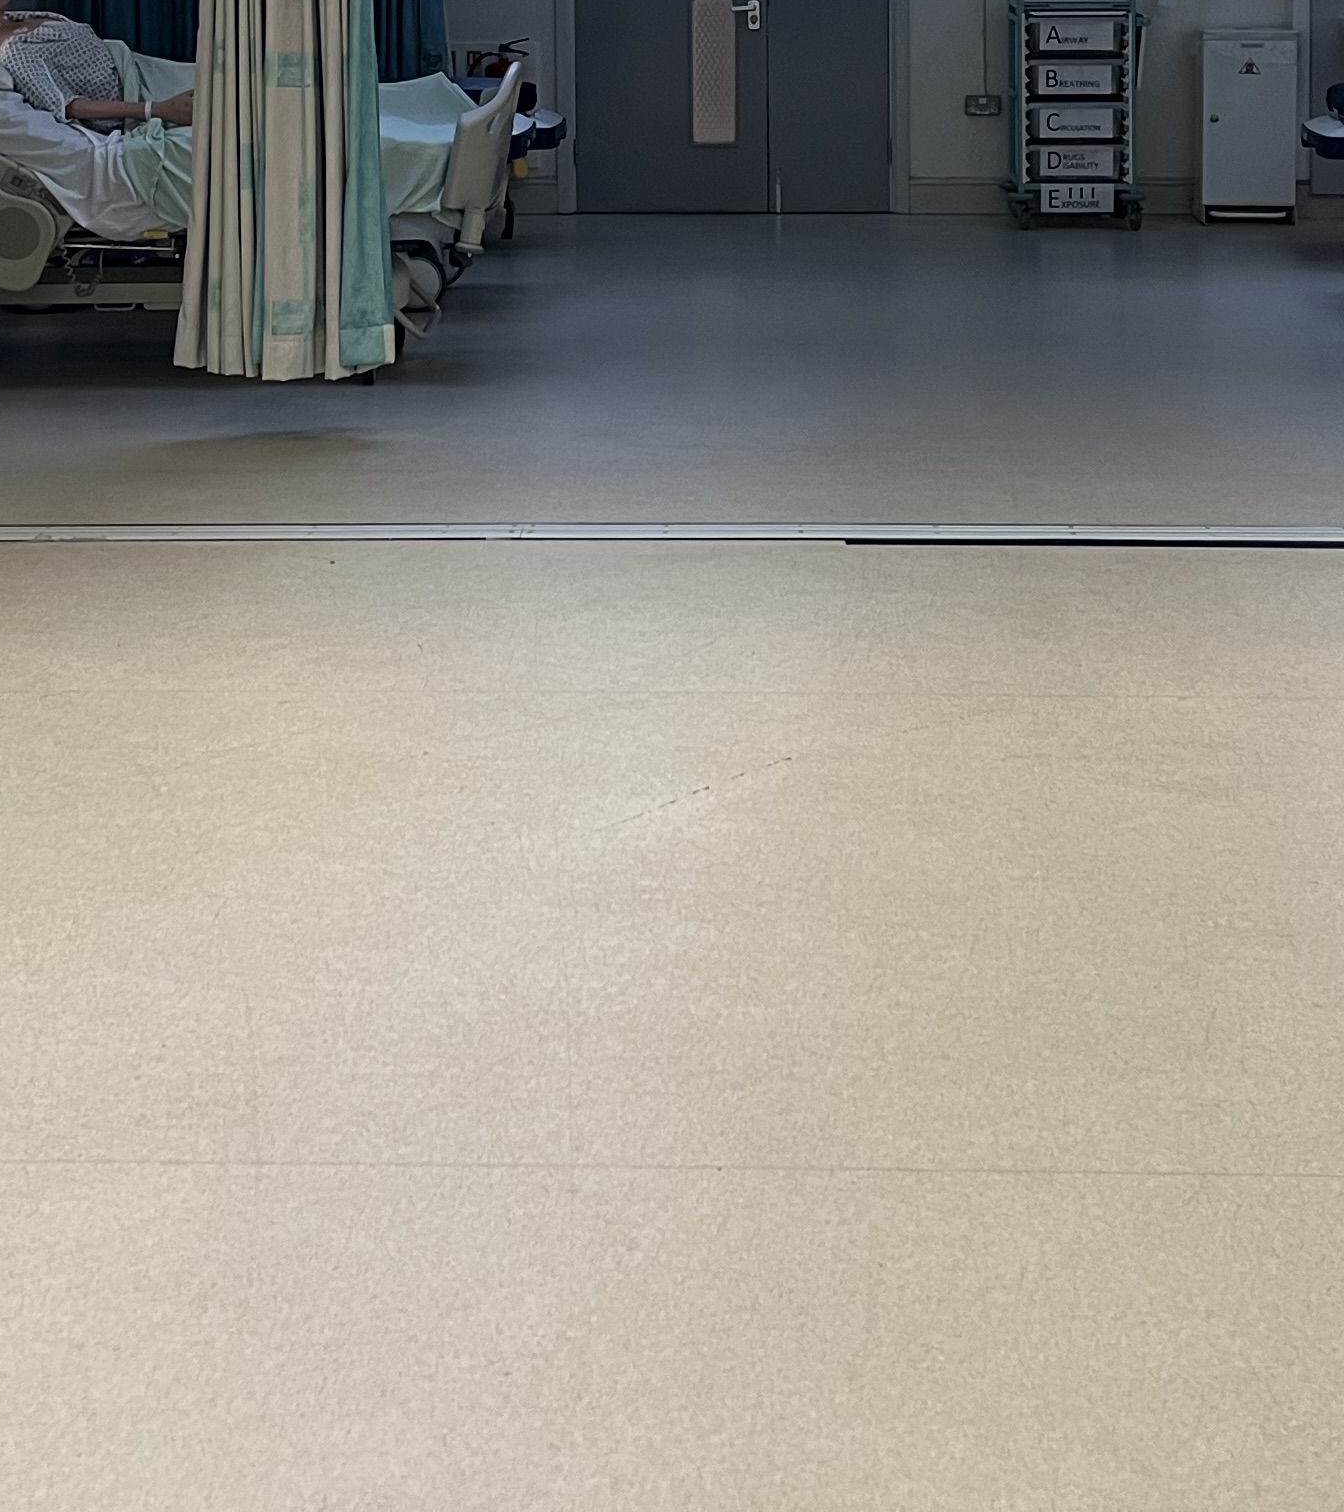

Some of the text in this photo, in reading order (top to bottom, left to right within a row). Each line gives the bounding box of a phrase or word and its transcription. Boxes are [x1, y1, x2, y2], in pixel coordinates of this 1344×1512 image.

[1045, 26, 1089, 44] AIRWAY
[1045, 70, 1100, 88] BREATHING
[1046, 113, 1101, 132] CIRCULATION
[1049, 189, 1101, 209] EXPOSURE
